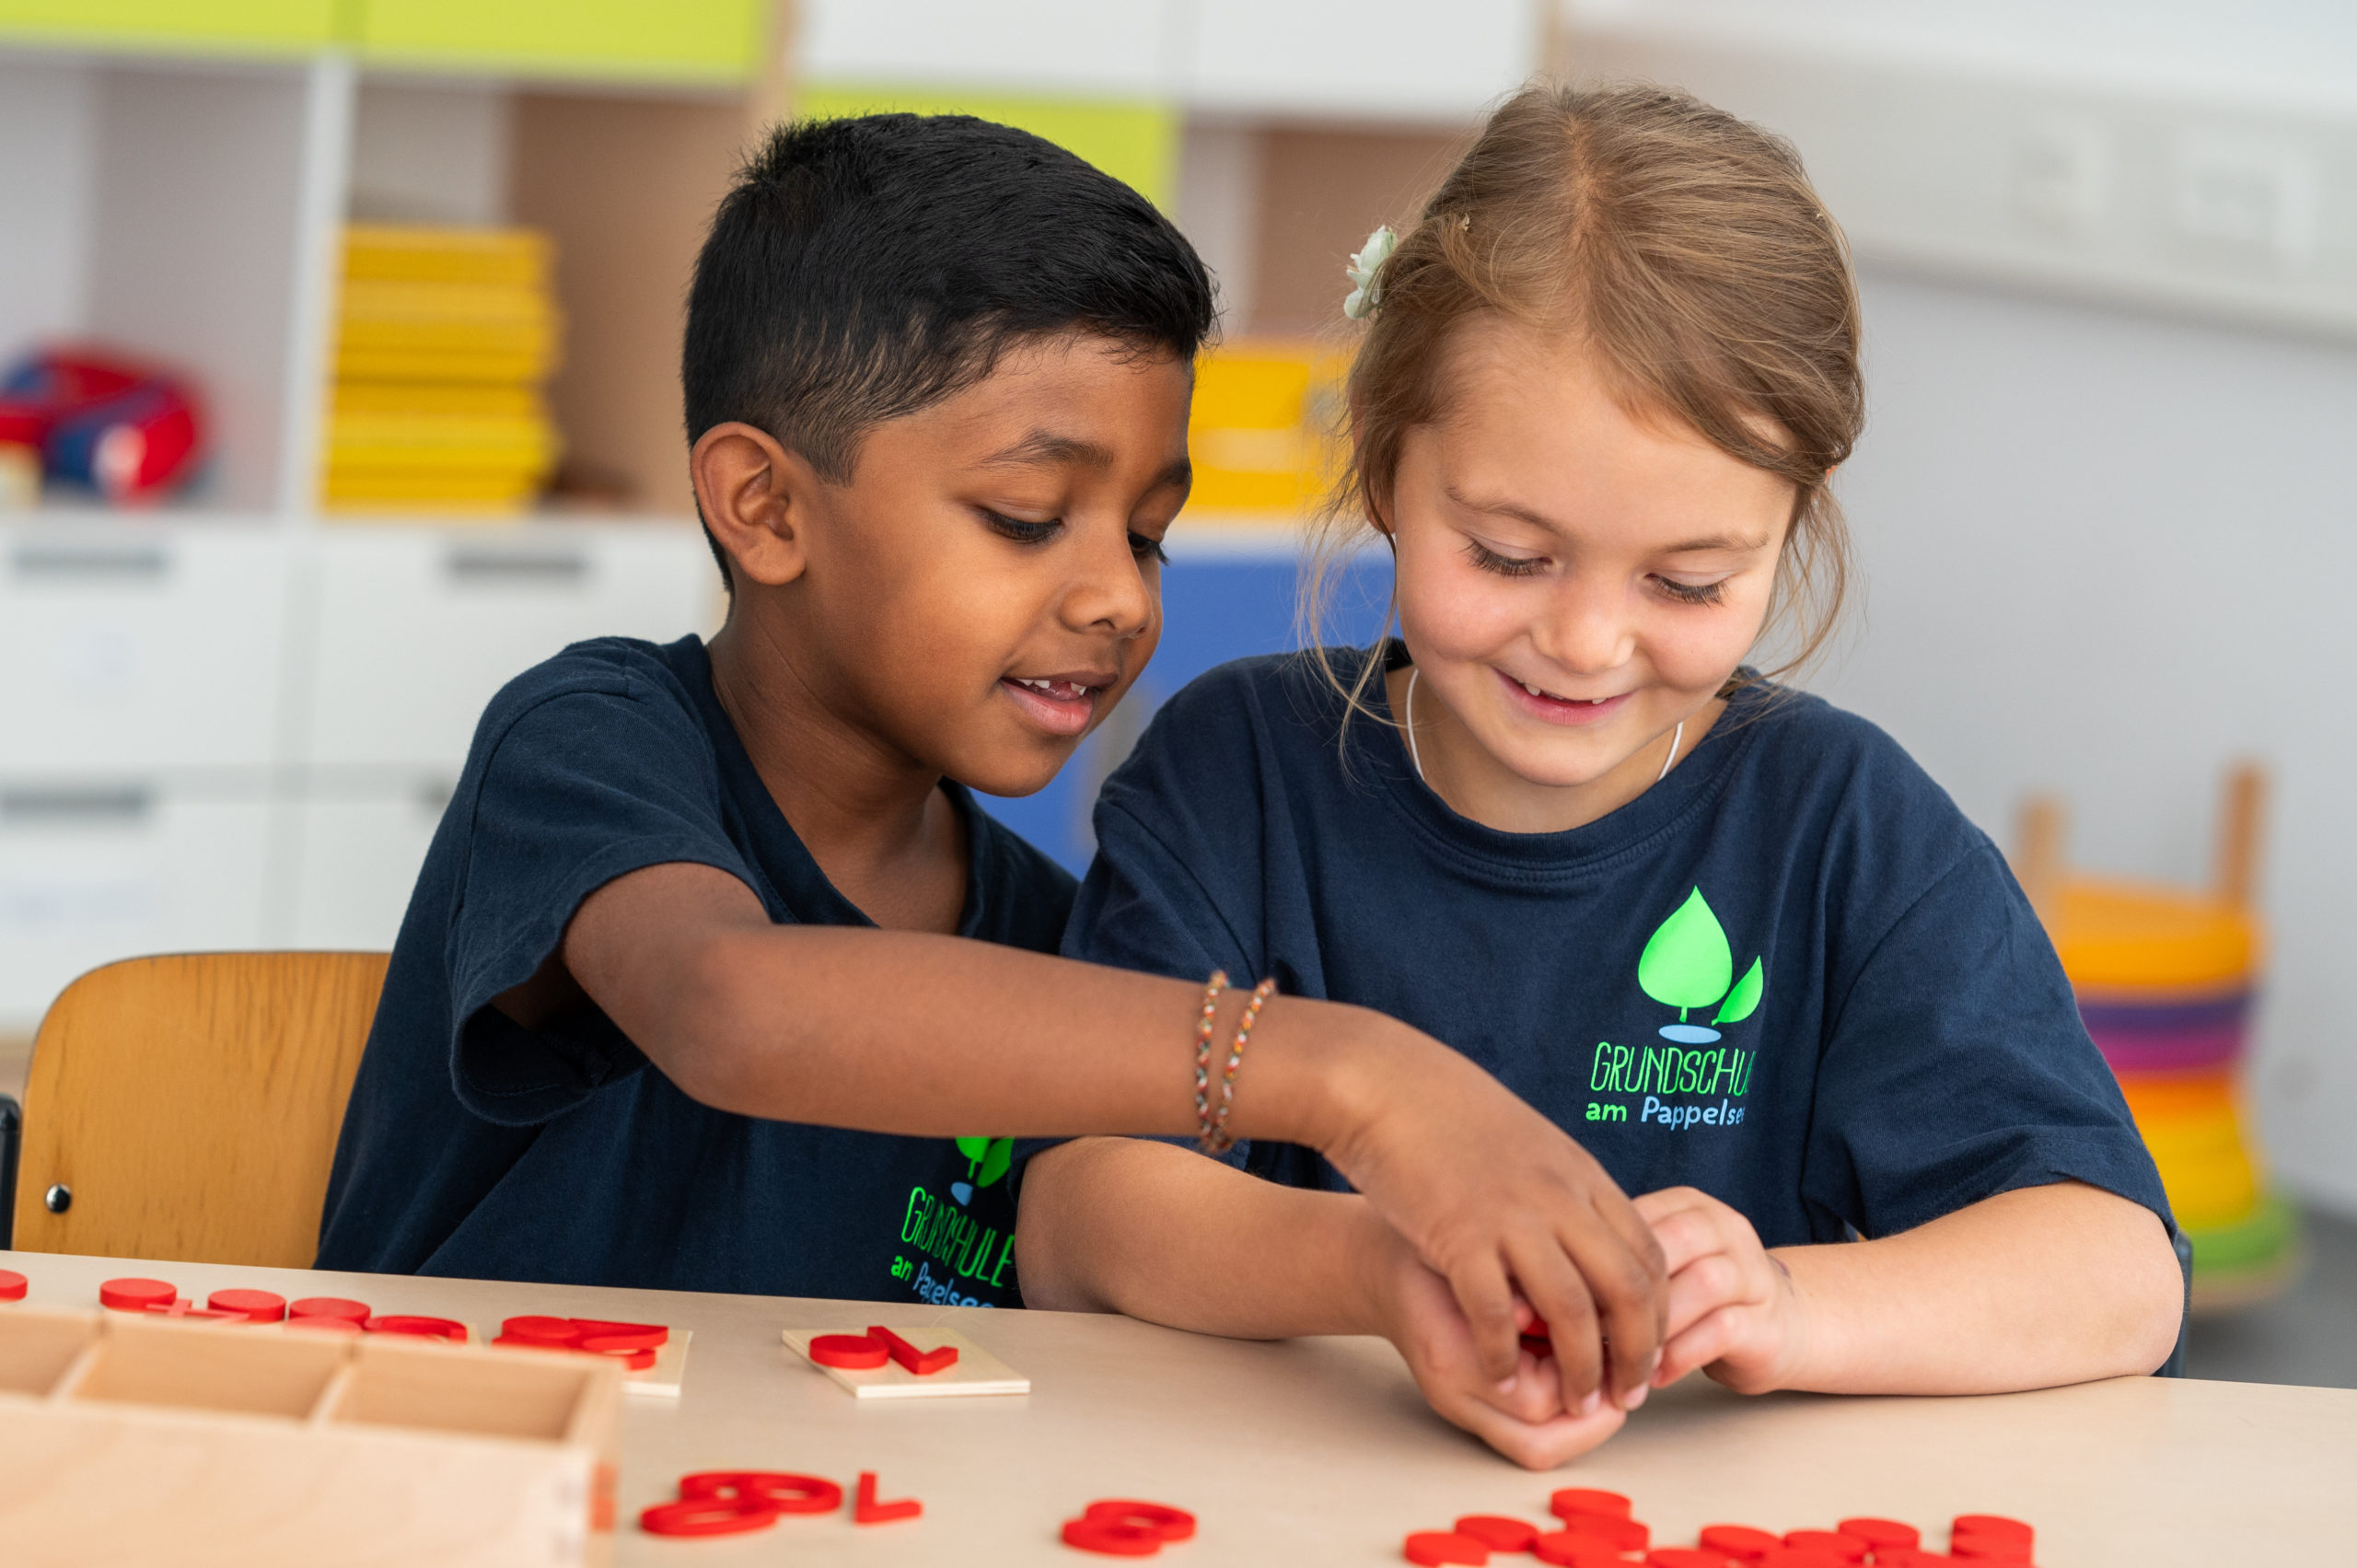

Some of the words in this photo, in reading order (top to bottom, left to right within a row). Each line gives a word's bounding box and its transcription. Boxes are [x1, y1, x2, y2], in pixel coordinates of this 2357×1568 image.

[1590, 1042, 1756, 1097] GRUNDSCHU
[1585, 1102, 1627, 1121] am
[1641, 1095, 1746, 1132] Pappelse
[901, 1186, 1015, 1287] GRUNHULE
